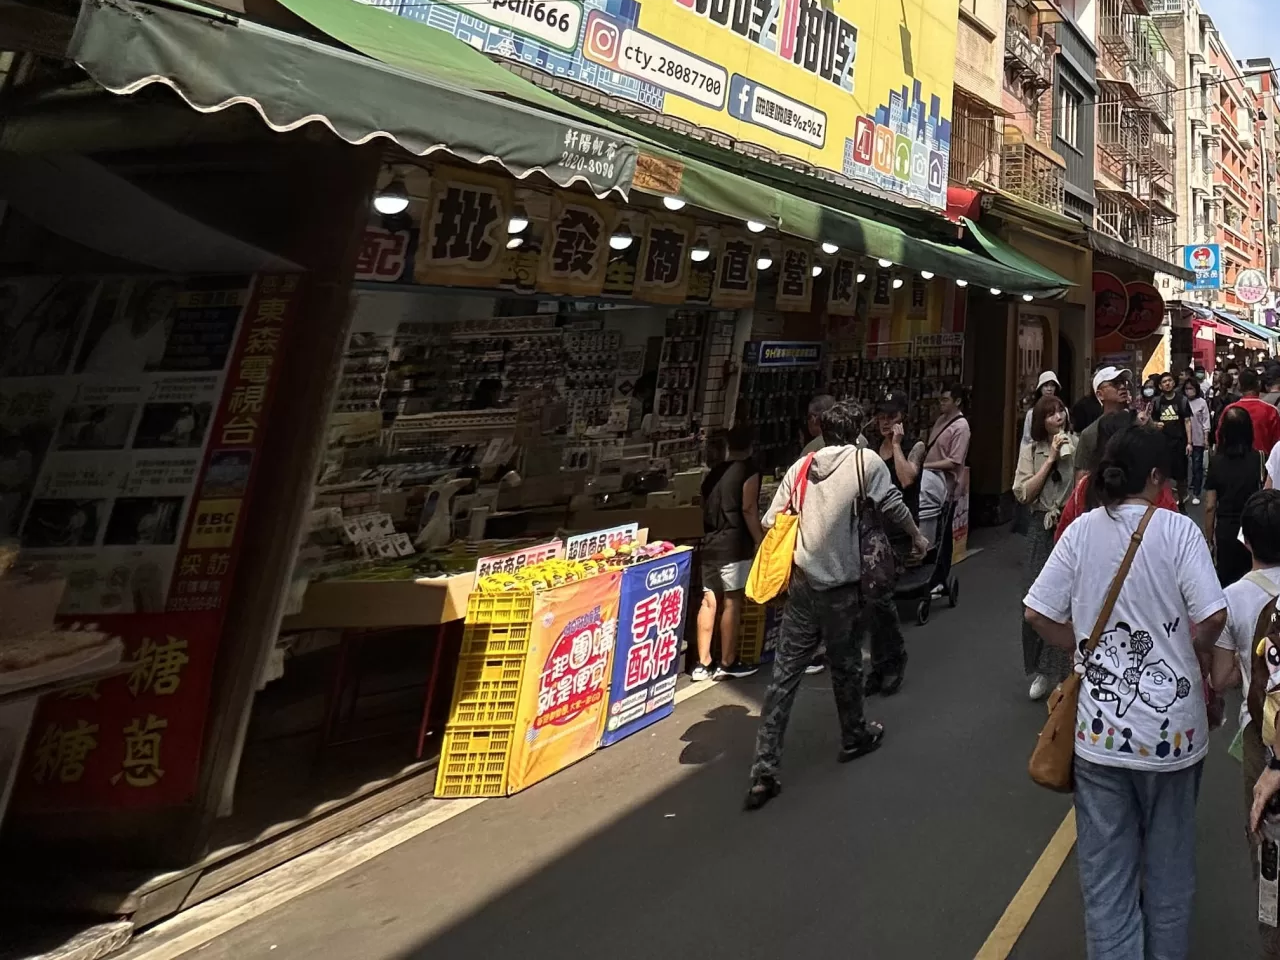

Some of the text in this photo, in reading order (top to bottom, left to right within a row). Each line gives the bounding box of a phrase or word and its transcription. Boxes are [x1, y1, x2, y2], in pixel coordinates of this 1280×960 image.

[624, 44, 722, 96] cty_28087700
[220, 298, 288, 445] 東森電視台
[634, 590, 682, 639] 手機
[626, 634, 676, 688] 配件
